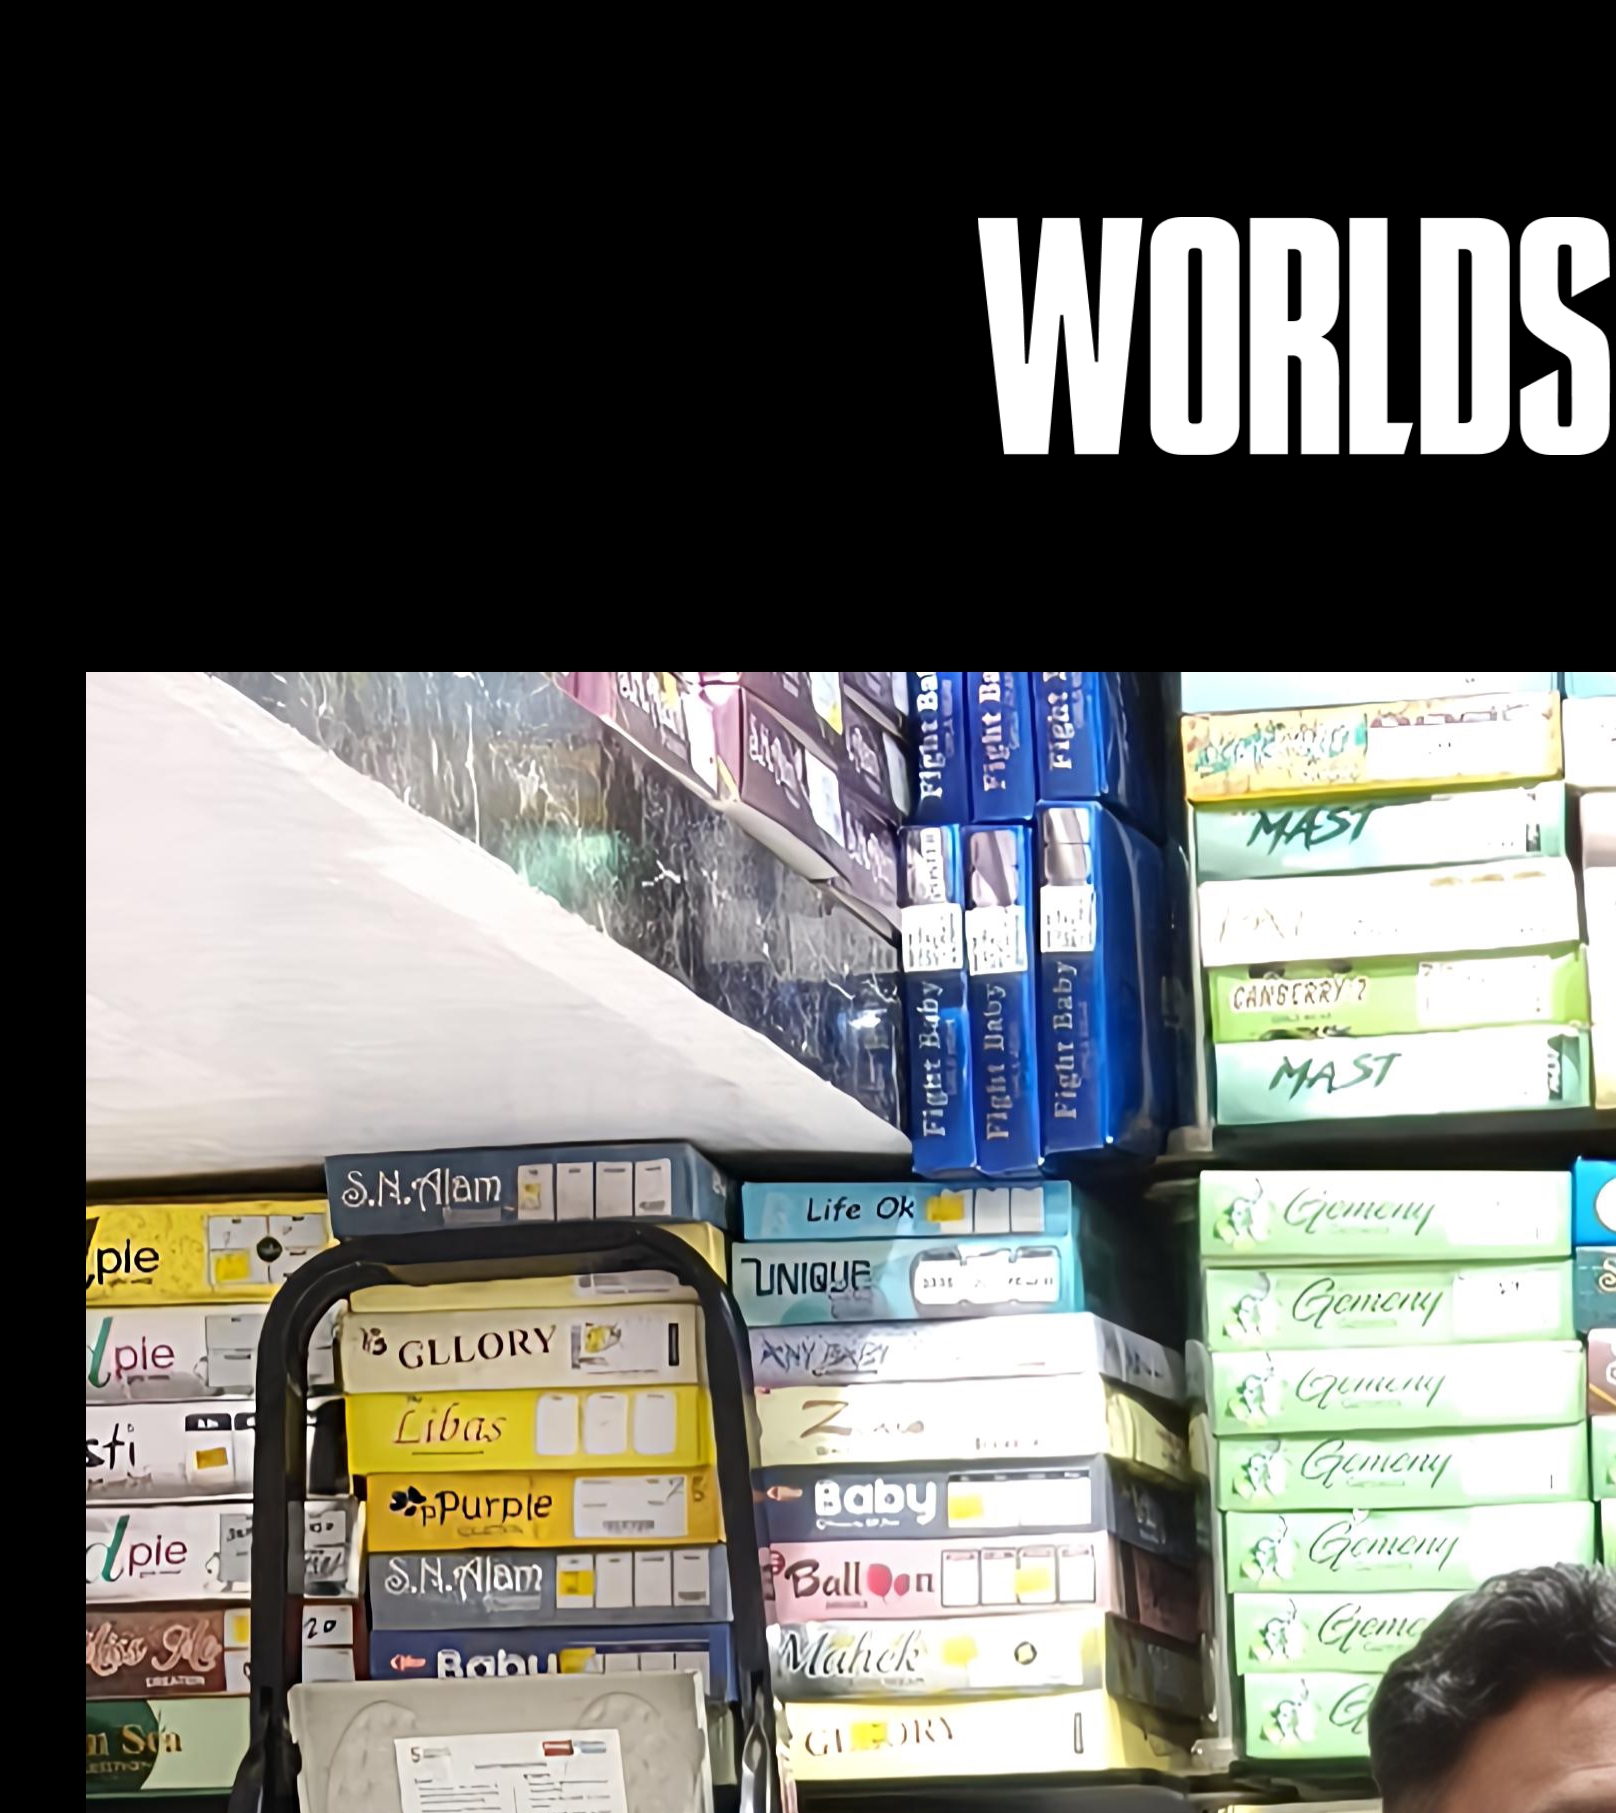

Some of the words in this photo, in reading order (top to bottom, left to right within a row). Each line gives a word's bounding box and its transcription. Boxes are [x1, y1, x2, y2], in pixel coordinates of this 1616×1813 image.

[1246, 807, 1376, 854] MAST
[1052, 961, 1078, 1030] Baby
[922, 1058, 948, 1137] Fight
[1269, 1053, 1402, 1099] MAST
[342, 1167, 500, 1212] S.N.Alam
[806, 1198, 861, 1222] Life
[876, 1196, 915, 1219] Ok
[741, 1257, 871, 1296] UNIQUE
[399, 1325, 556, 1369] GLLORY
[393, 1402, 507, 1444] Libas
[814, 1478, 936, 1526] Baby
[385, 1557, 544, 1598] S.N.Alam
